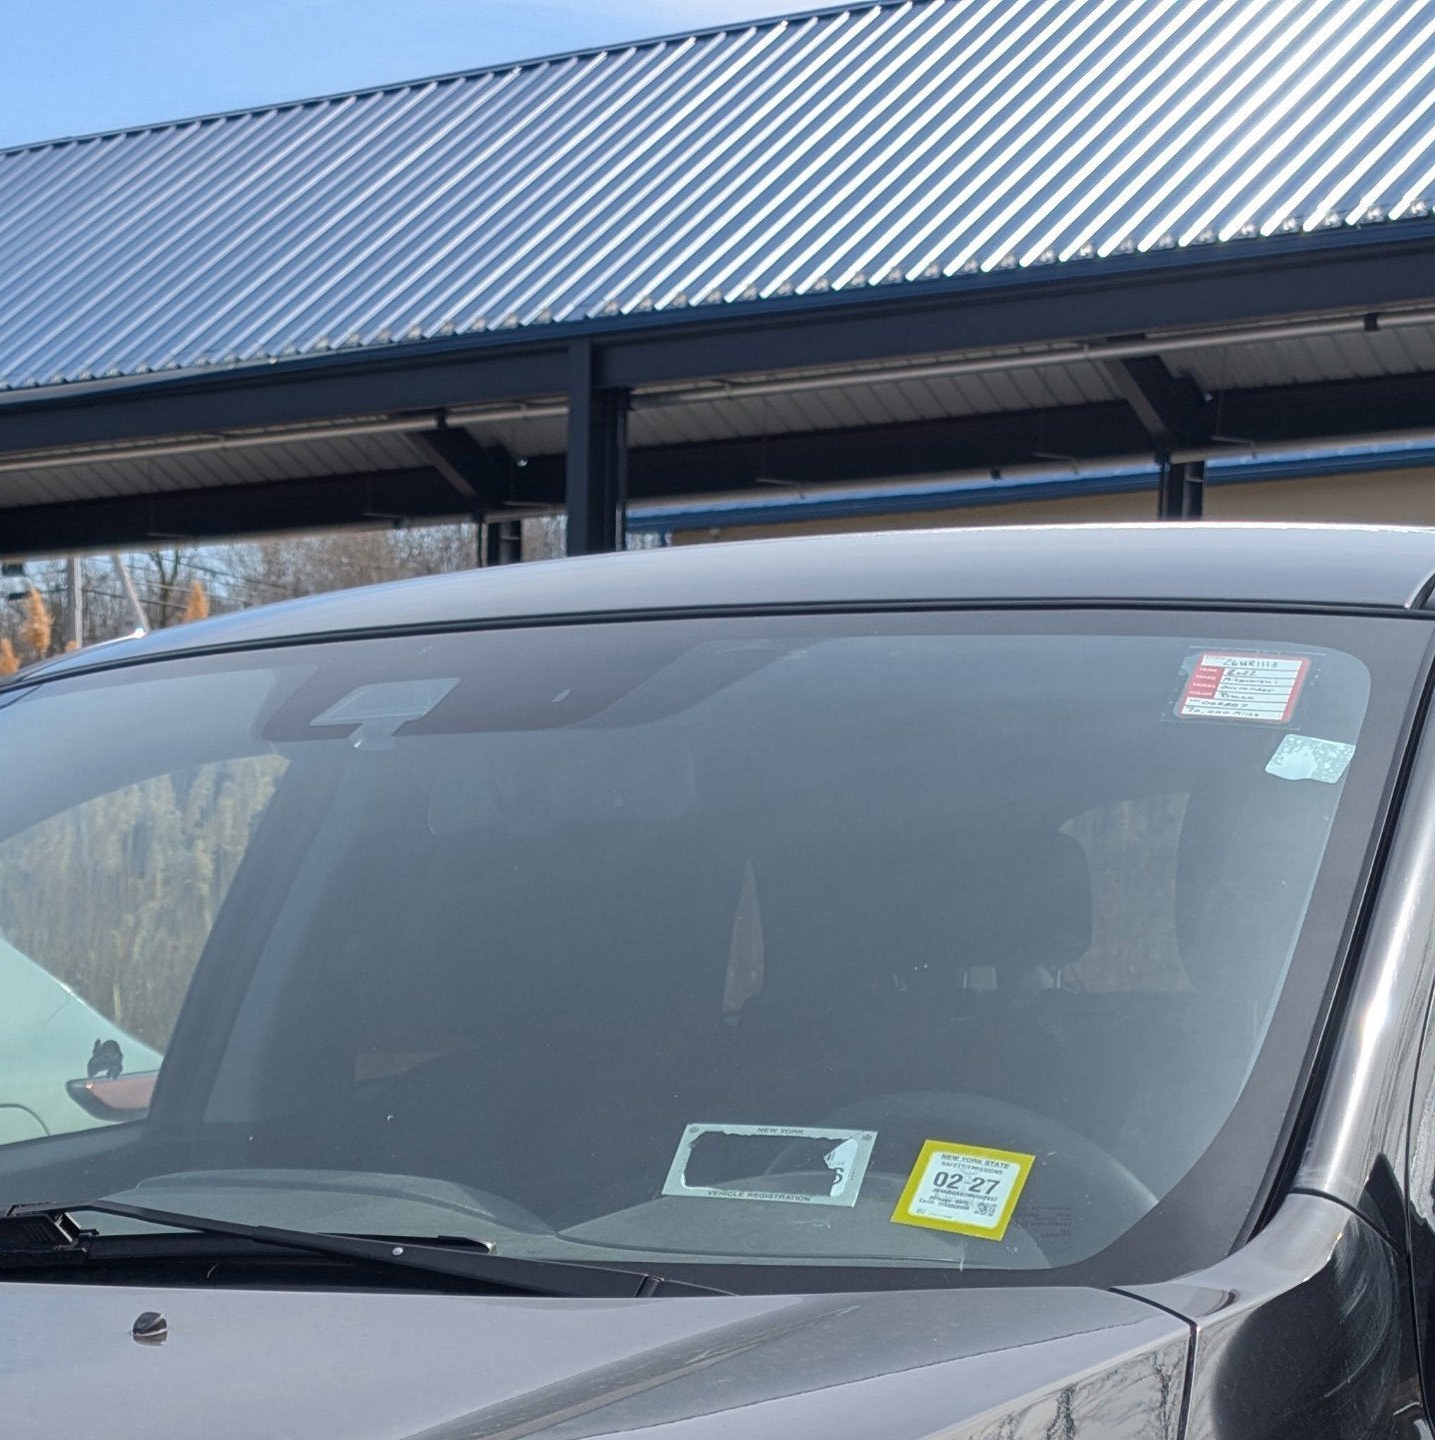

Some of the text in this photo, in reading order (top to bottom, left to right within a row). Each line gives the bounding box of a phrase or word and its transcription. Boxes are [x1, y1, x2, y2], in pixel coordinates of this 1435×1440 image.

[941, 1153, 1010, 1169] NEW YORK STATE
[707, 1190, 812, 1202] VEHICLE REGISTRATION
